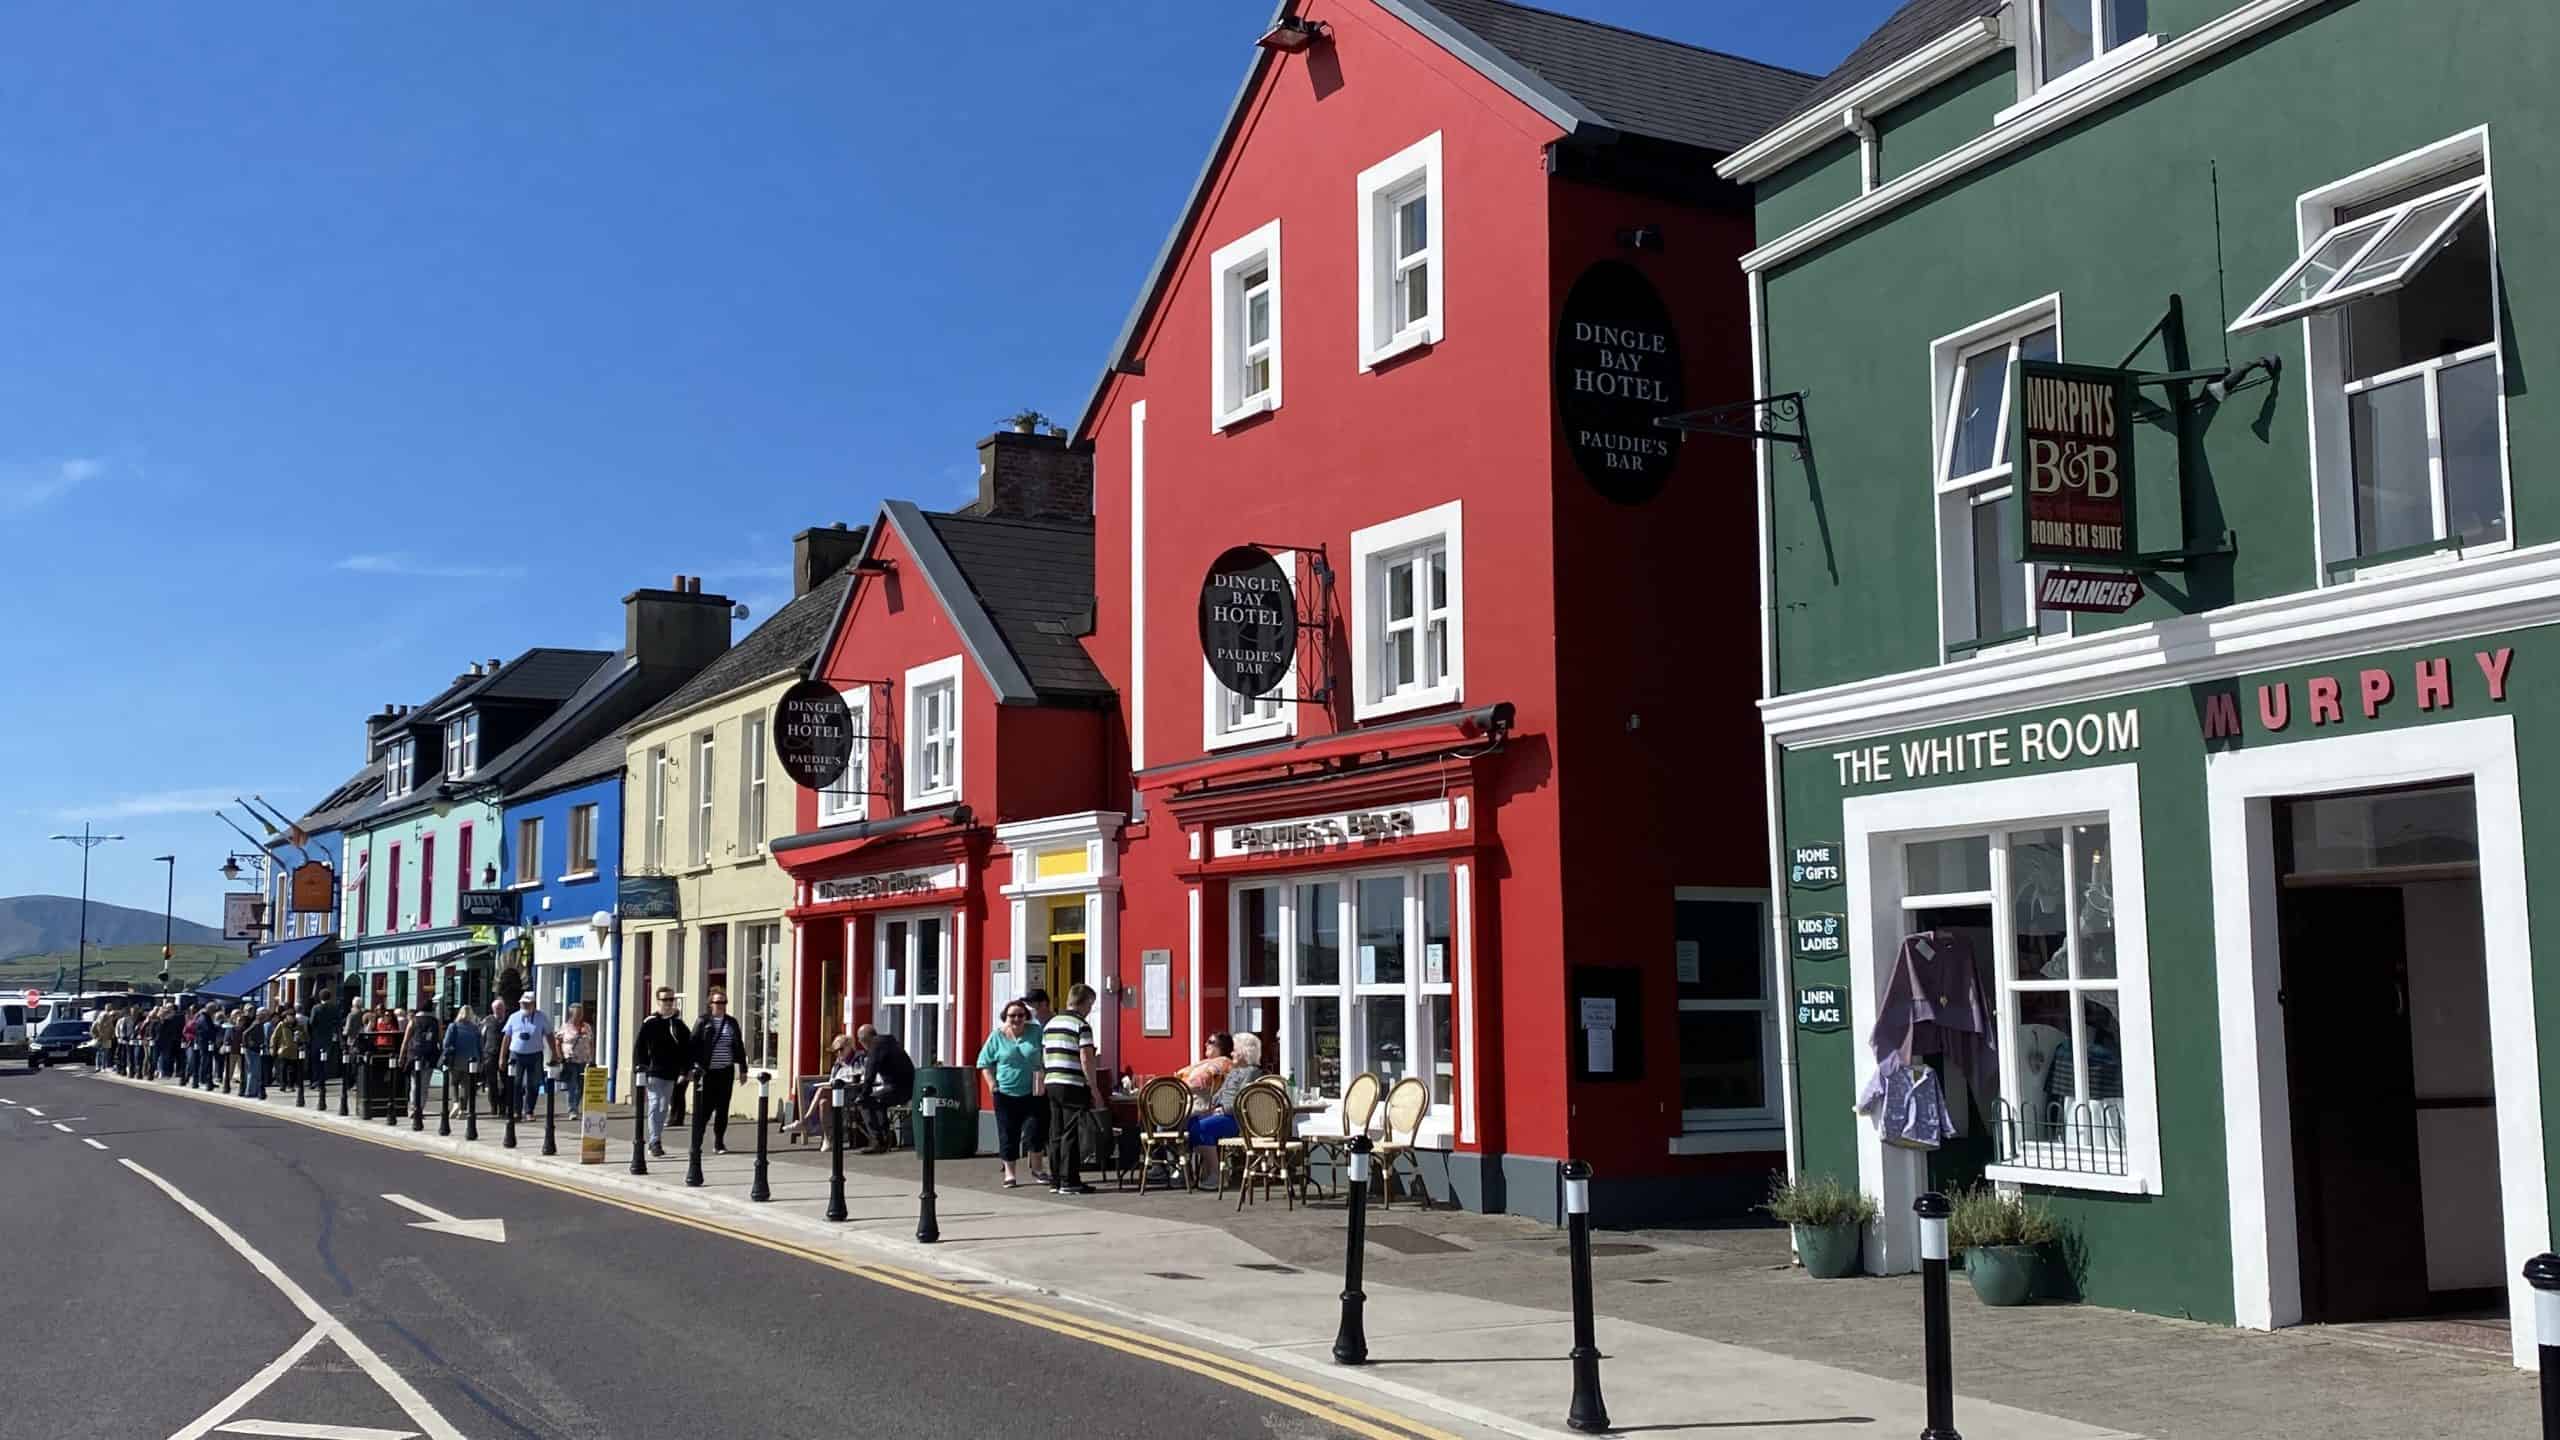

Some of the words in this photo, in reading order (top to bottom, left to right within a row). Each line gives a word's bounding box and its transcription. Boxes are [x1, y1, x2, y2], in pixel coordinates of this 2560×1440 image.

[1575, 322, 1667, 353] DINGLE
[1600, 349, 1643, 372] BAY
[1575, 368, 1669, 402] HOTEL
[2027, 376, 2115, 438] MURPHYS
[1580, 430, 1668, 456] PAUDIE'S
[1606, 452, 1643, 471] BAR
[2029, 438, 2119, 498] B&B
[2031, 520, 2072, 547] ROOMS
[2075, 524, 2089, 548] EN
[2092, 525, 2123, 551] SUITE
[1214, 574, 1281, 592] DINGLE
[1232, 592, 1264, 606] BAY
[2042, 578, 2138, 606] VACANCIES
[1213, 606, 1282, 626] HOTEL
[1217, 648, 1281, 663] PAUDIE'S
[1236, 662, 1263, 674] BAR
[2204, 648, 2511, 738] MURPHY
[788, 701, 842, 713] DINGLE
[803, 713, 828, 724] BAY
[788, 724, 841, 738] HOTEL
[1833, 745, 1892, 785] THE
[1900, 729, 2010, 779] WHITE
[2020, 709, 2140, 763] ROOM
[790, 754, 841, 764] PAUDIE'S
[804, 765, 826, 773] BAR
[1796, 848, 1830, 863] HOME
[1806, 866, 1838, 880] GIFTS
[1798, 919, 1823, 934] KIDS
[1800, 937, 1839, 951] LADIES
[1801, 990, 1834, 1004] LINEN
[1811, 1008, 1839, 1022] LACE
